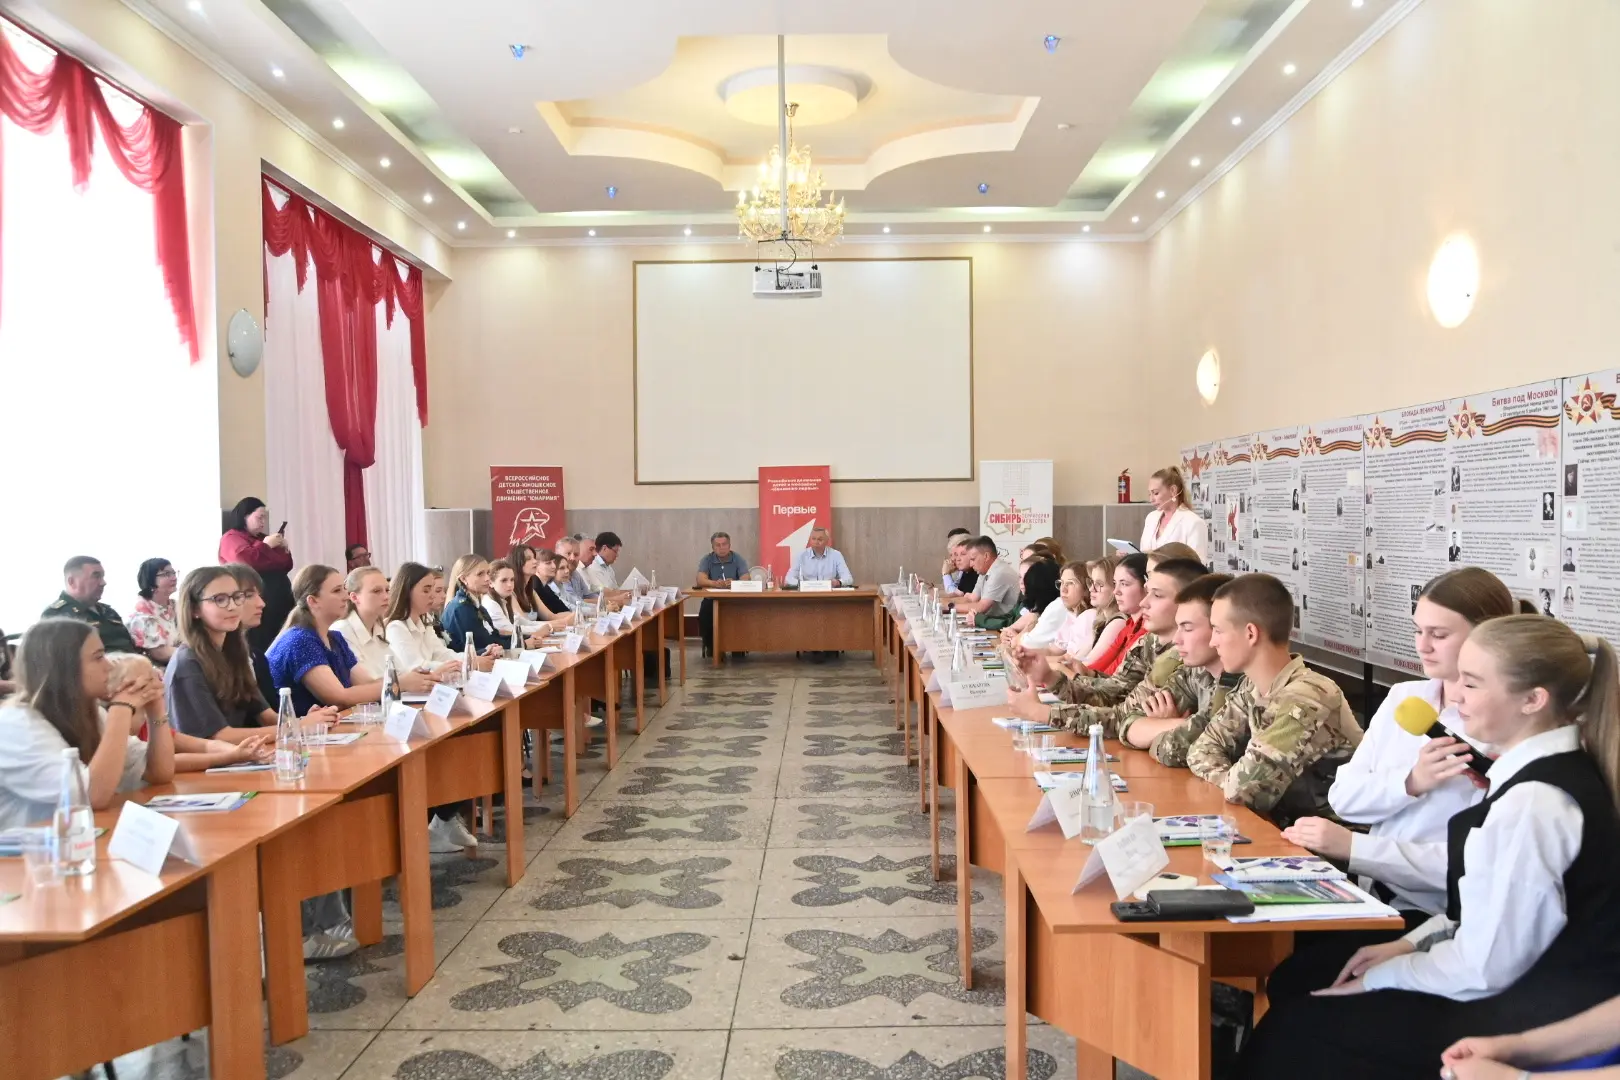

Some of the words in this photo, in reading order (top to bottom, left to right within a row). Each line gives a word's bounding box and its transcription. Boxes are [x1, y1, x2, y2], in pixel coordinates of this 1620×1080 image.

[1492, 398, 1511, 406] Битва
[1512, 394, 1526, 403] под
[1527, 388, 1558, 400] Москвой
[772, 504, 816, 517] Первые
[990, 513, 1021, 524] СИБИРЬ
